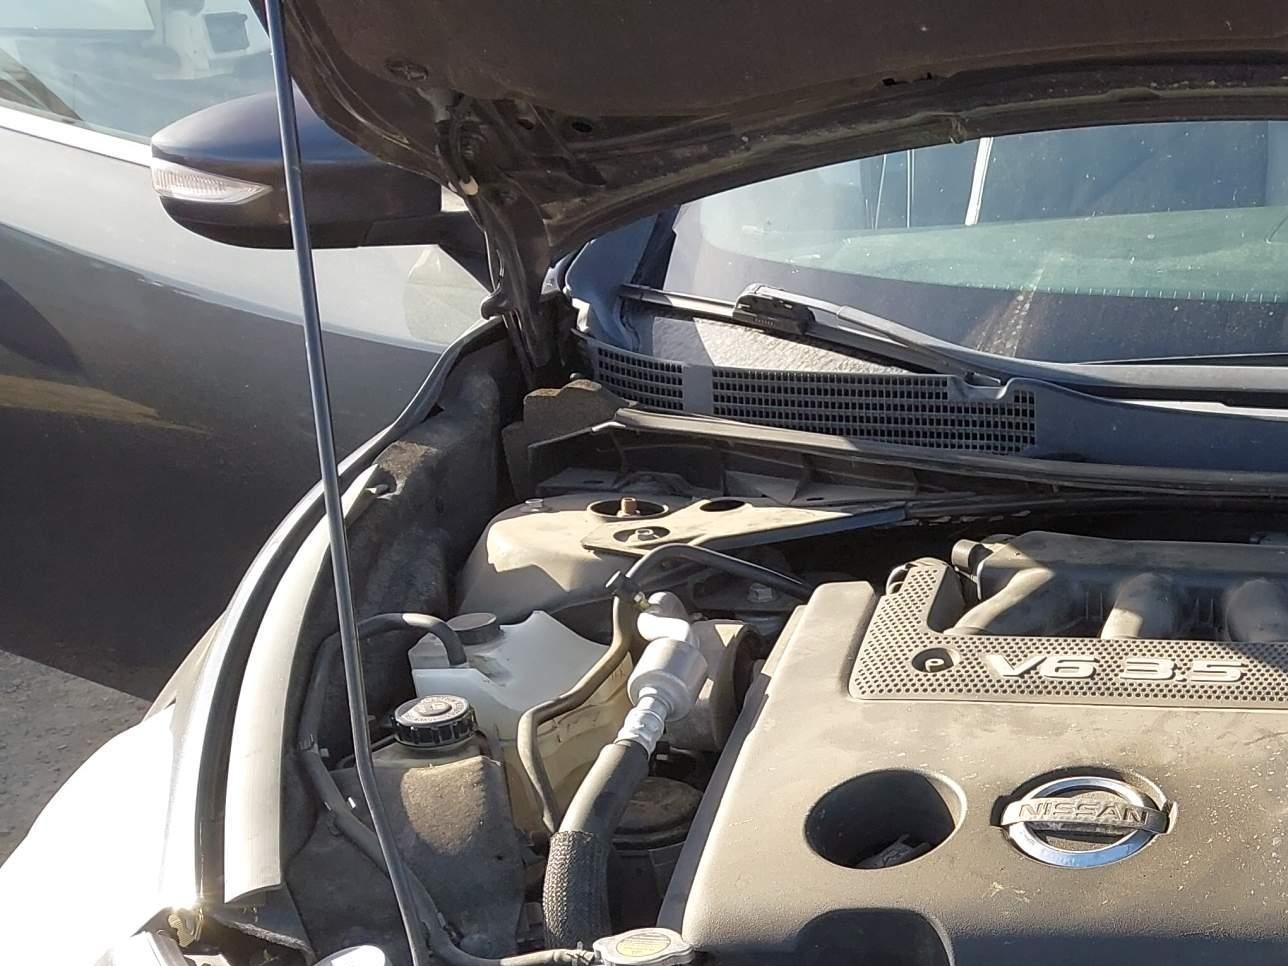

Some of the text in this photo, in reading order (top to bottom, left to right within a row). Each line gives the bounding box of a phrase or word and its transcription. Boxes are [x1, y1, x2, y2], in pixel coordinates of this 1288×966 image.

[985, 655, 1248, 683] V6 3.5
[1018, 801, 1149, 826] NISSAN
